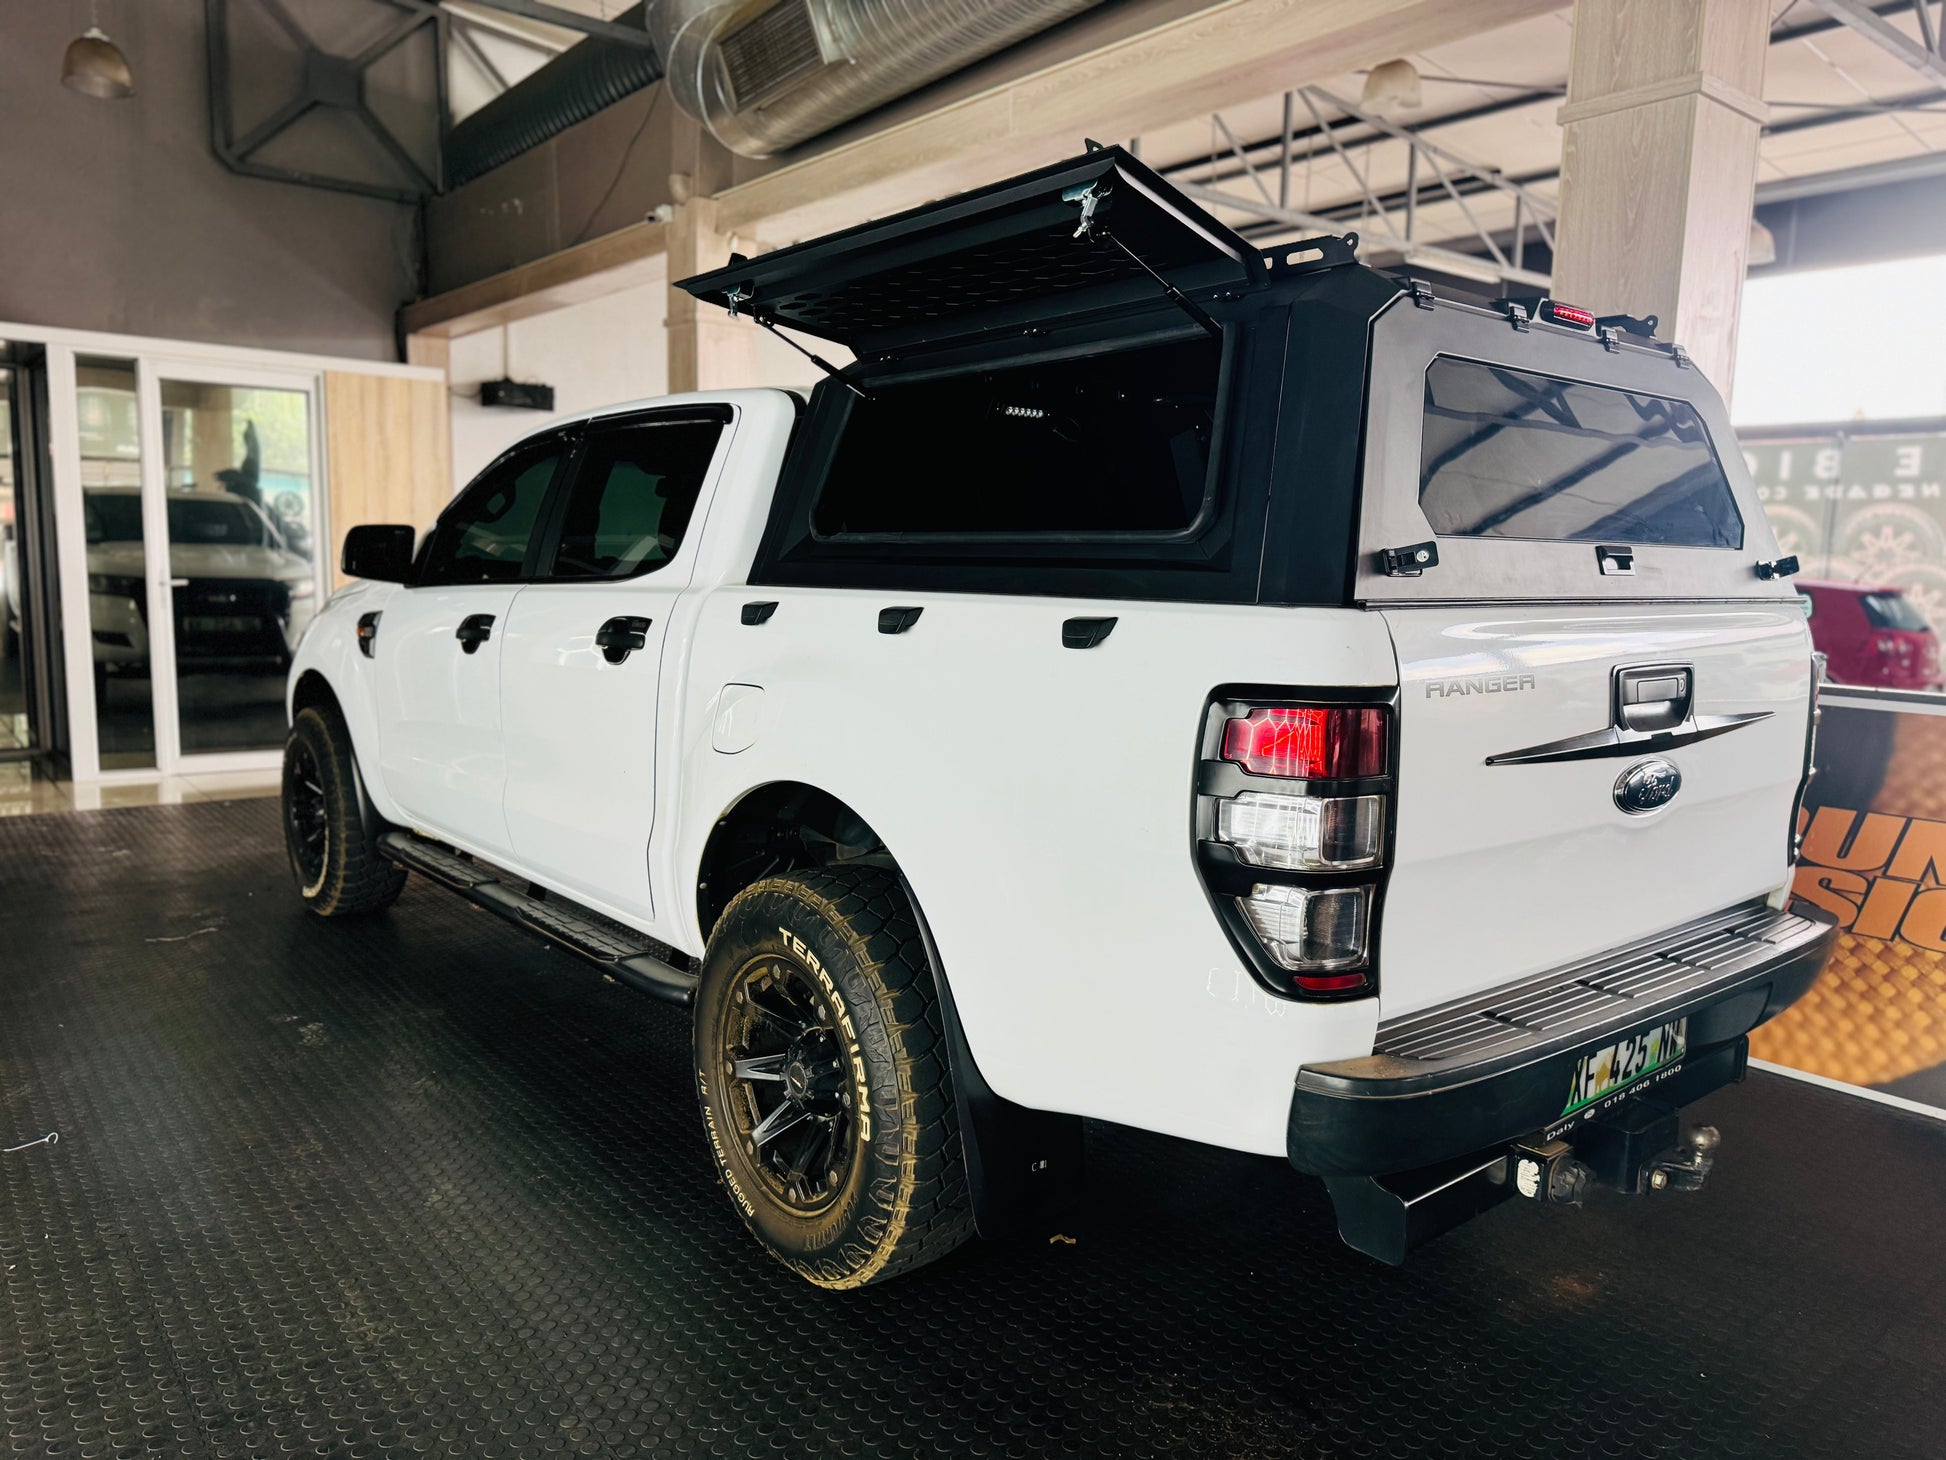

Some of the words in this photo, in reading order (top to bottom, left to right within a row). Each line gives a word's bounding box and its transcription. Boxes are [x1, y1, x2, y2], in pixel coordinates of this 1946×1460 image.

[1425, 674, 1536, 699] RANGER
[778, 926, 871, 1142] TERRAFIRMA
[1546, 1121, 1575, 1142] Daly
[1604, 1092, 1625, 1109] 018
[1628, 1079, 1651, 1095] 406
[1655, 1064, 1682, 1082] 1800
[704, 1106, 727, 1167] TERRAIN
[725, 1169, 755, 1217] RUGGED
